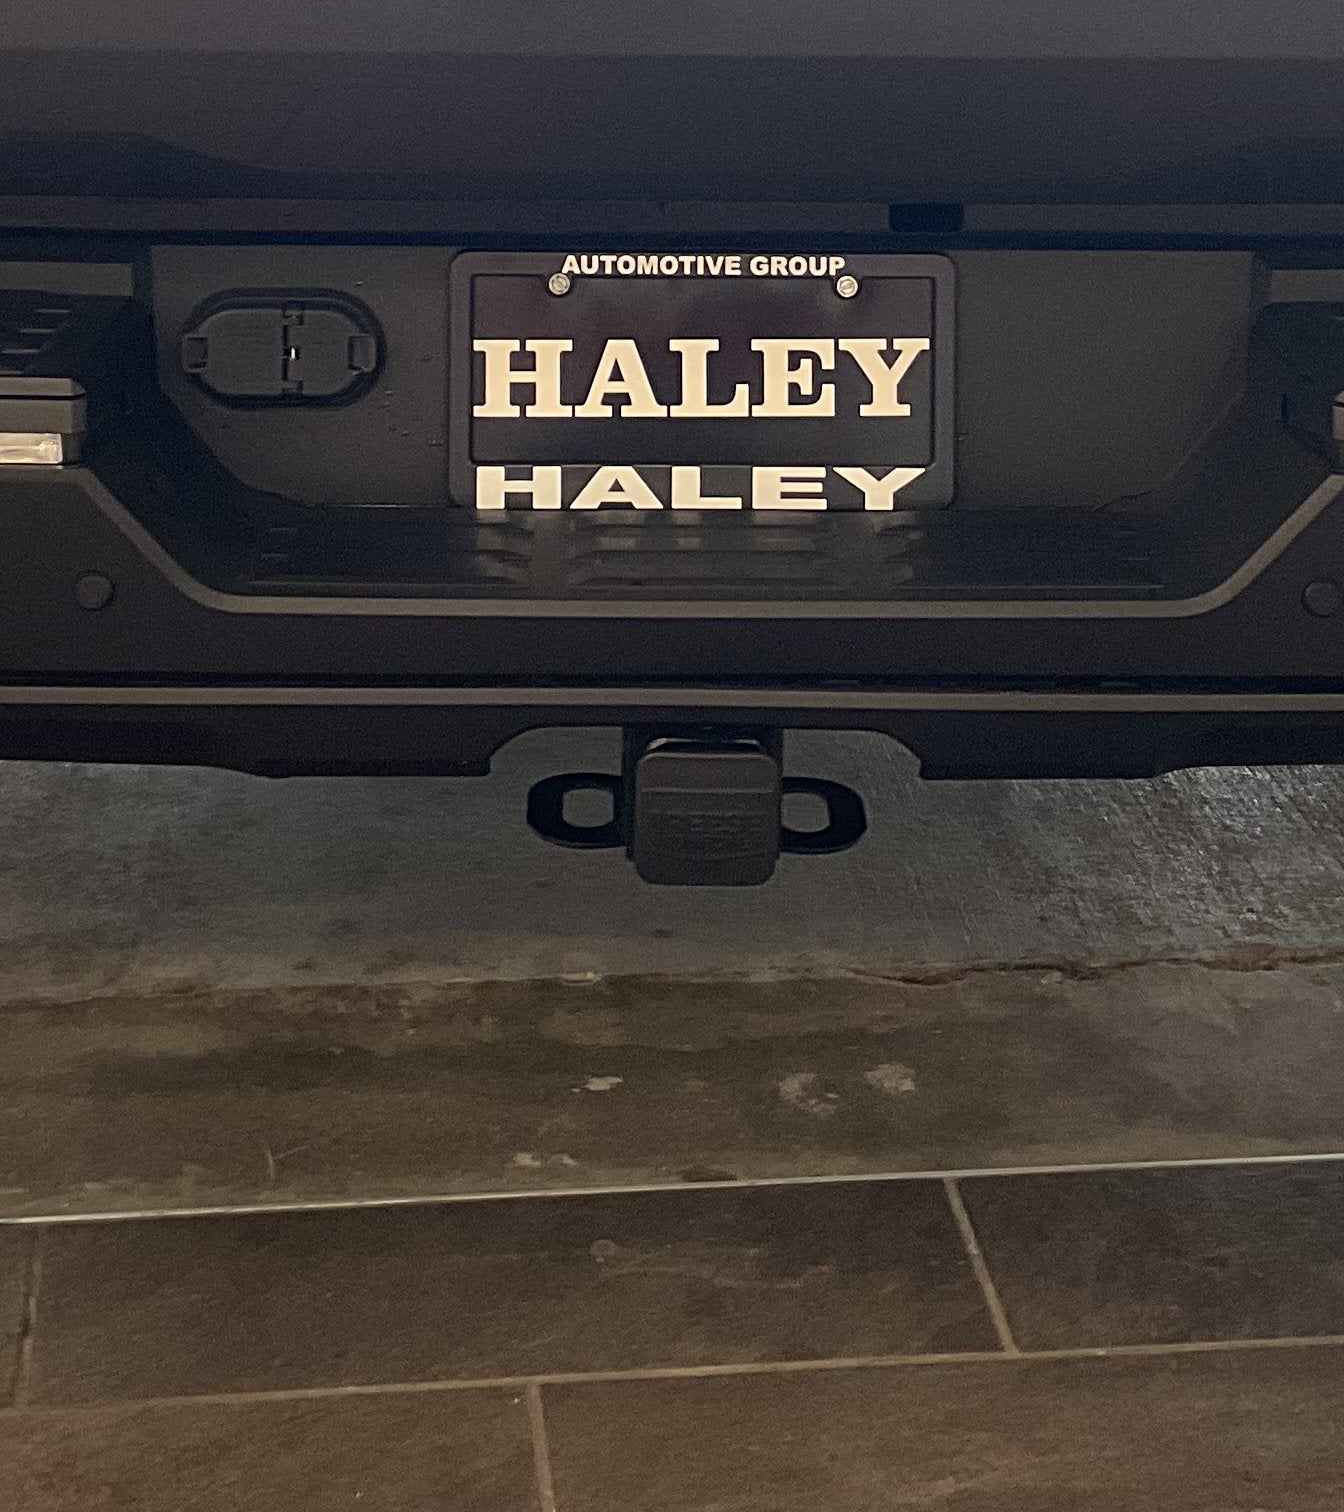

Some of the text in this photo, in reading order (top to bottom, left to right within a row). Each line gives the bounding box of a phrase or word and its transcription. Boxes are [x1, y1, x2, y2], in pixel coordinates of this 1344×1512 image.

[560, 253, 847, 276] AUTOMOTIVE GROUP
[472, 337, 931, 419] HALEY
[474, 464, 927, 511] HALEY
